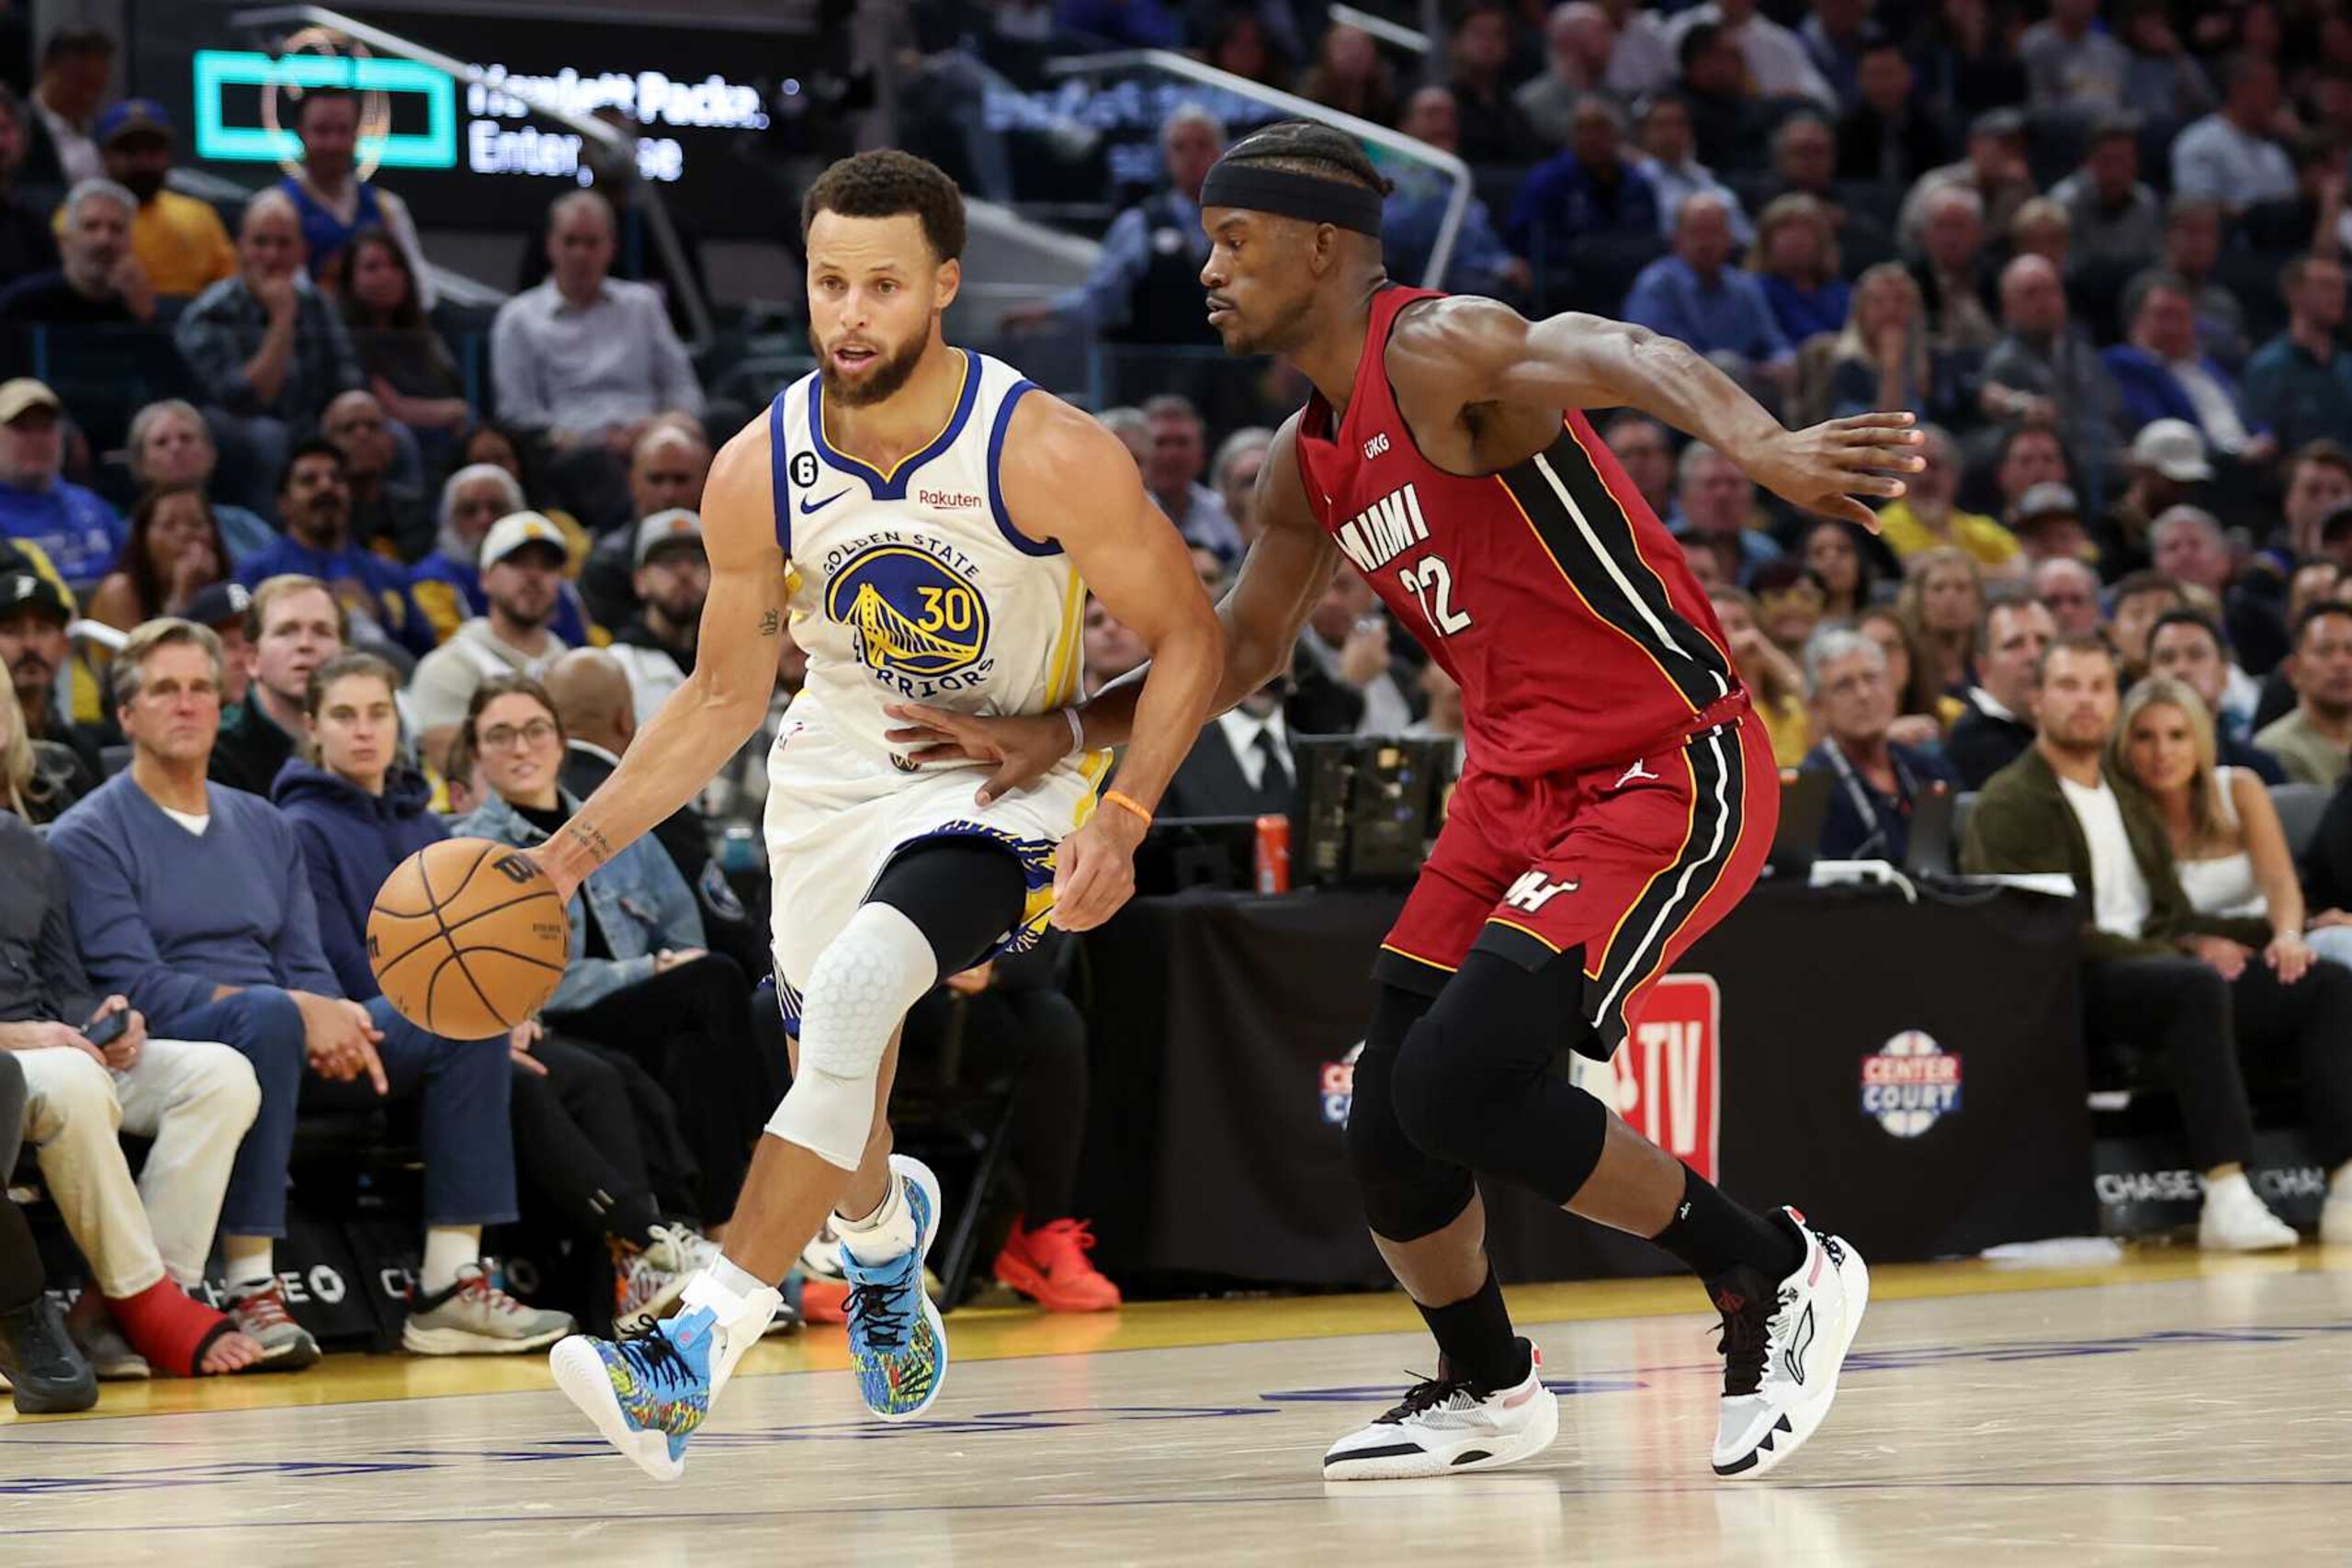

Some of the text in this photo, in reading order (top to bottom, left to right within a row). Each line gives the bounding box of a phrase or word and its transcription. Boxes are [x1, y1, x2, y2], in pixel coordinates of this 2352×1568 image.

[797, 456, 814, 481] 6
[919, 490, 982, 508] Rakuten
[1332, 482, 1430, 573] MIAMI
[823, 531, 979, 579] GOLDEN STATE
[917, 586, 972, 632] 30
[1863, 1056, 1959, 1084] CENTER
[1636, 1021, 1703, 1156] TV
[1863, 1085, 1957, 1111] COURT
[2094, 1169, 2199, 1204] CHASE
